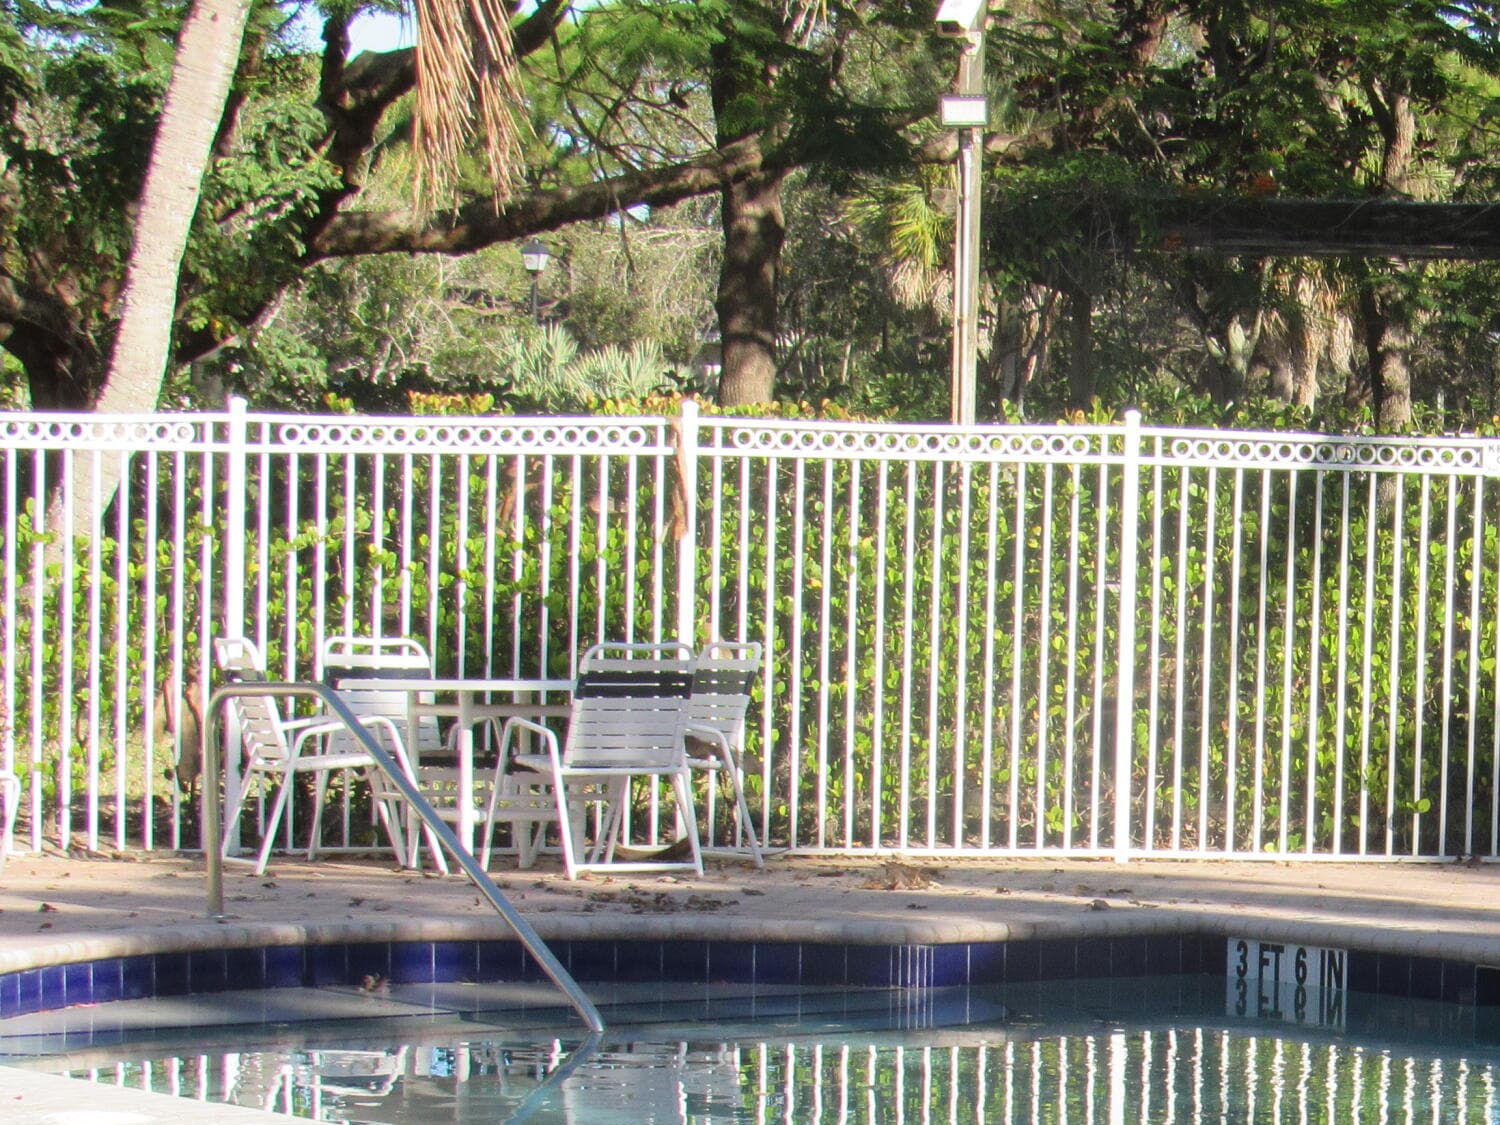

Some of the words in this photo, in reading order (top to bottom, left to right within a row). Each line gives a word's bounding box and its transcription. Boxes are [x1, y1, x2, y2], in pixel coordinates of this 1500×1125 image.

[1236, 940, 1248, 977] 3
[1258, 943, 1285, 982] FT
[1295, 947, 1307, 985] 6
[1320, 949, 1344, 990] IN
